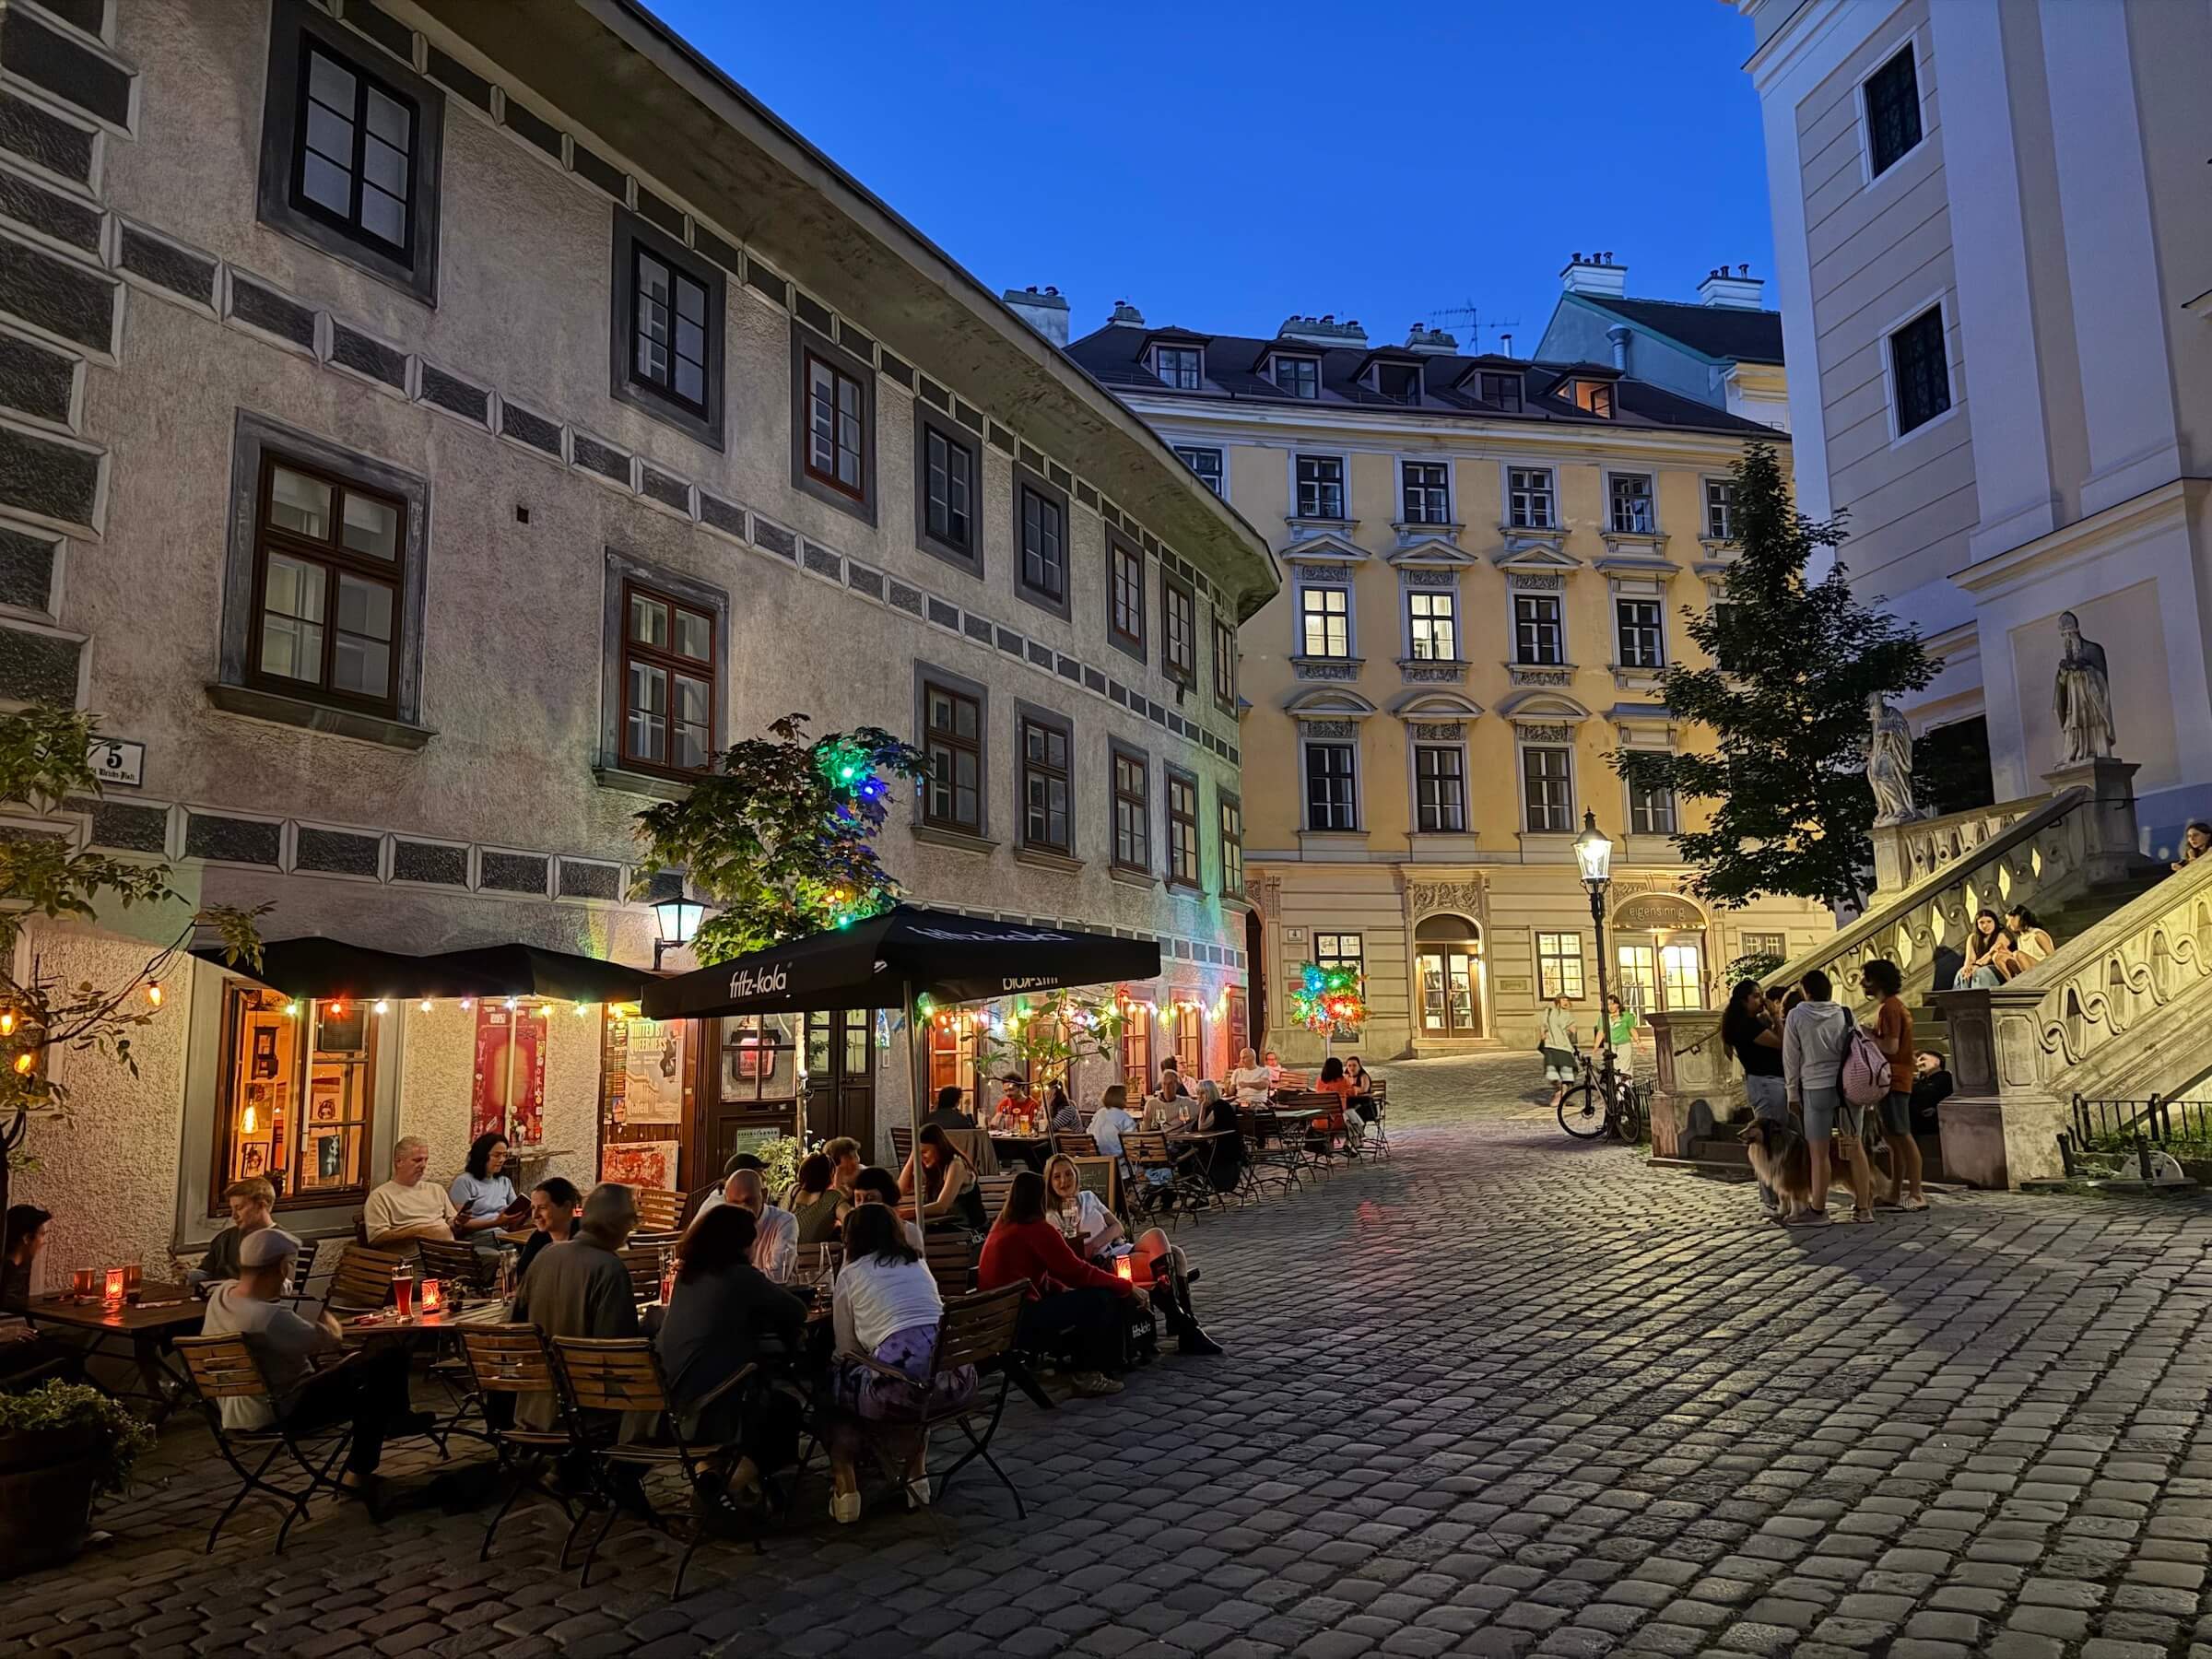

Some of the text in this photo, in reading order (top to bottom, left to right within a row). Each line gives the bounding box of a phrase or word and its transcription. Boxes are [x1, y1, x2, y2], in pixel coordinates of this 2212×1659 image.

[106, 743, 123, 769] 5
[1629, 906, 1686, 922] eigensinnig
[729, 963, 787, 999] fritz-kola
[655, 1022, 665, 1038] BY
[629, 1038, 667, 1054] QUEERNESS
